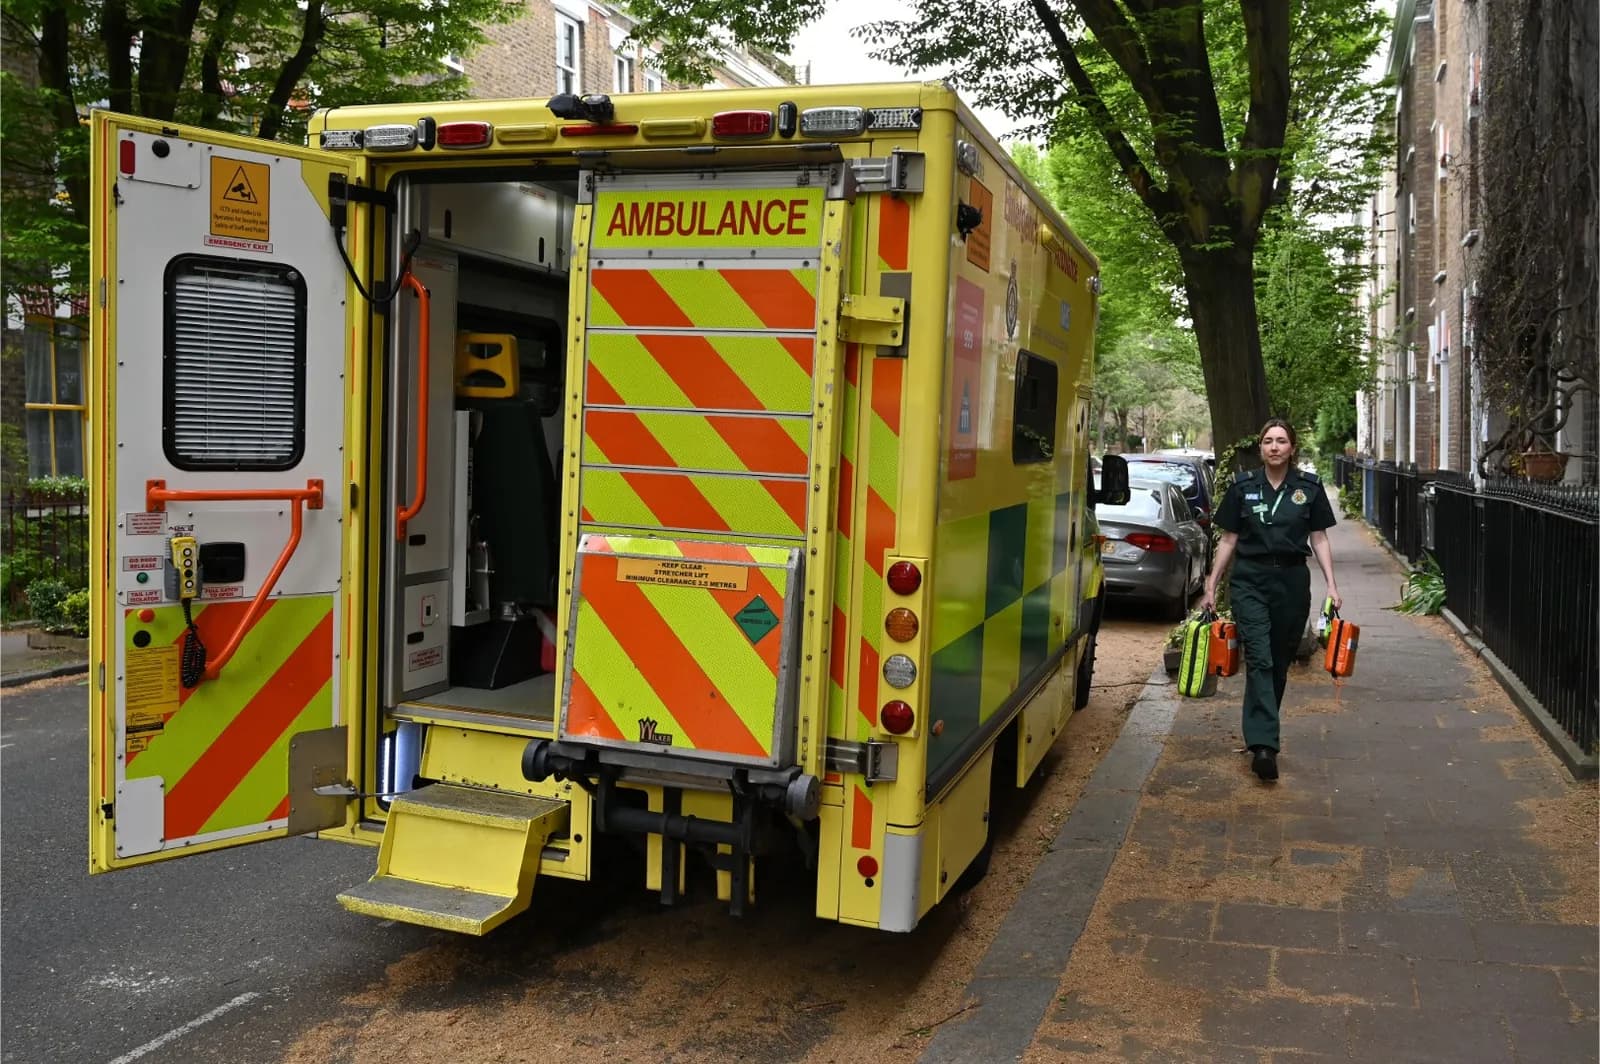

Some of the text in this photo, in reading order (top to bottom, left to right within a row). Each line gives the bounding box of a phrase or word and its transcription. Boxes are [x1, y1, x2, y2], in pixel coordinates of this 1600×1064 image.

[606, 199, 809, 236] AMBULANCE
[208, 238, 268, 251] EMERGENCY EXIT
[661, 562, 680, 570] KEEP
[680, 563, 703, 571] CLEAR
[653, 569, 693, 578] STRETCHER
[625, 574, 656, 583] MINIMUM
[657, 576, 697, 586] CLEARANCE
[709, 580, 738, 589] METRES
